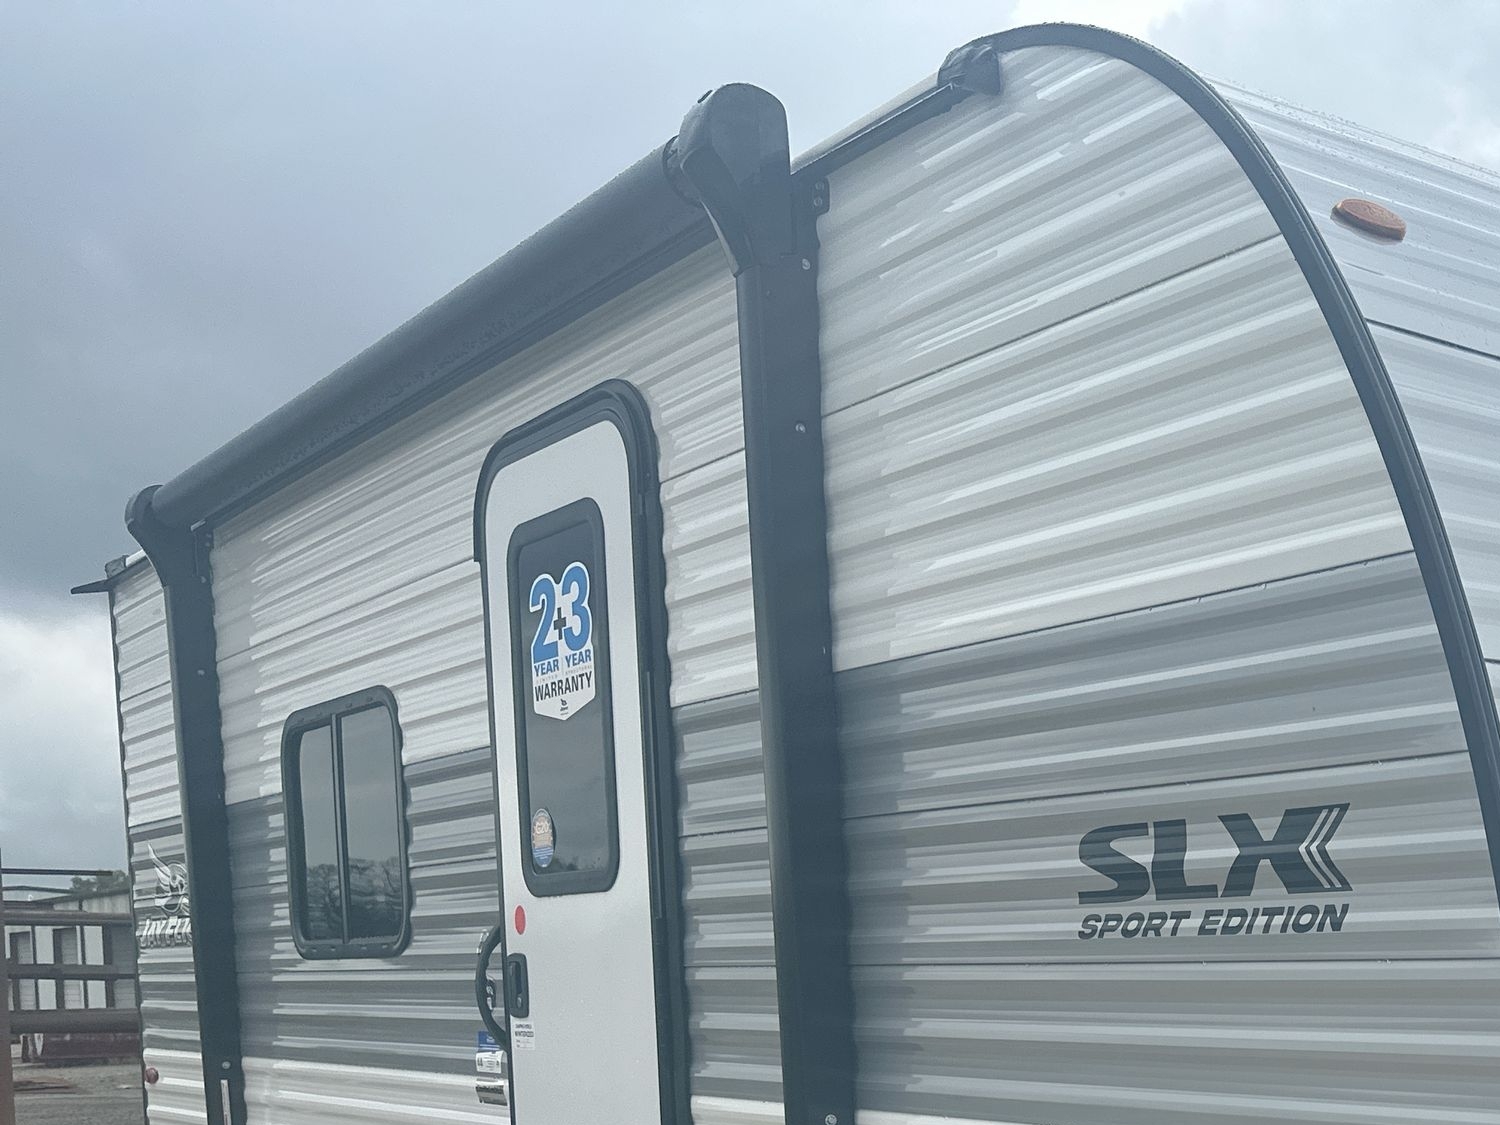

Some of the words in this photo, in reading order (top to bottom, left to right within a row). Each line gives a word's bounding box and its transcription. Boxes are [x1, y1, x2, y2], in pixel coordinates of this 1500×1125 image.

[534, 659, 559, 677] YEAR
[565, 649, 592, 668] YEAR
[534, 670, 592, 702] WARRANTY
[1078, 803, 1353, 905] SLX
[1077, 910, 1191, 940] SPORT
[1198, 903, 1350, 936] EDITION
